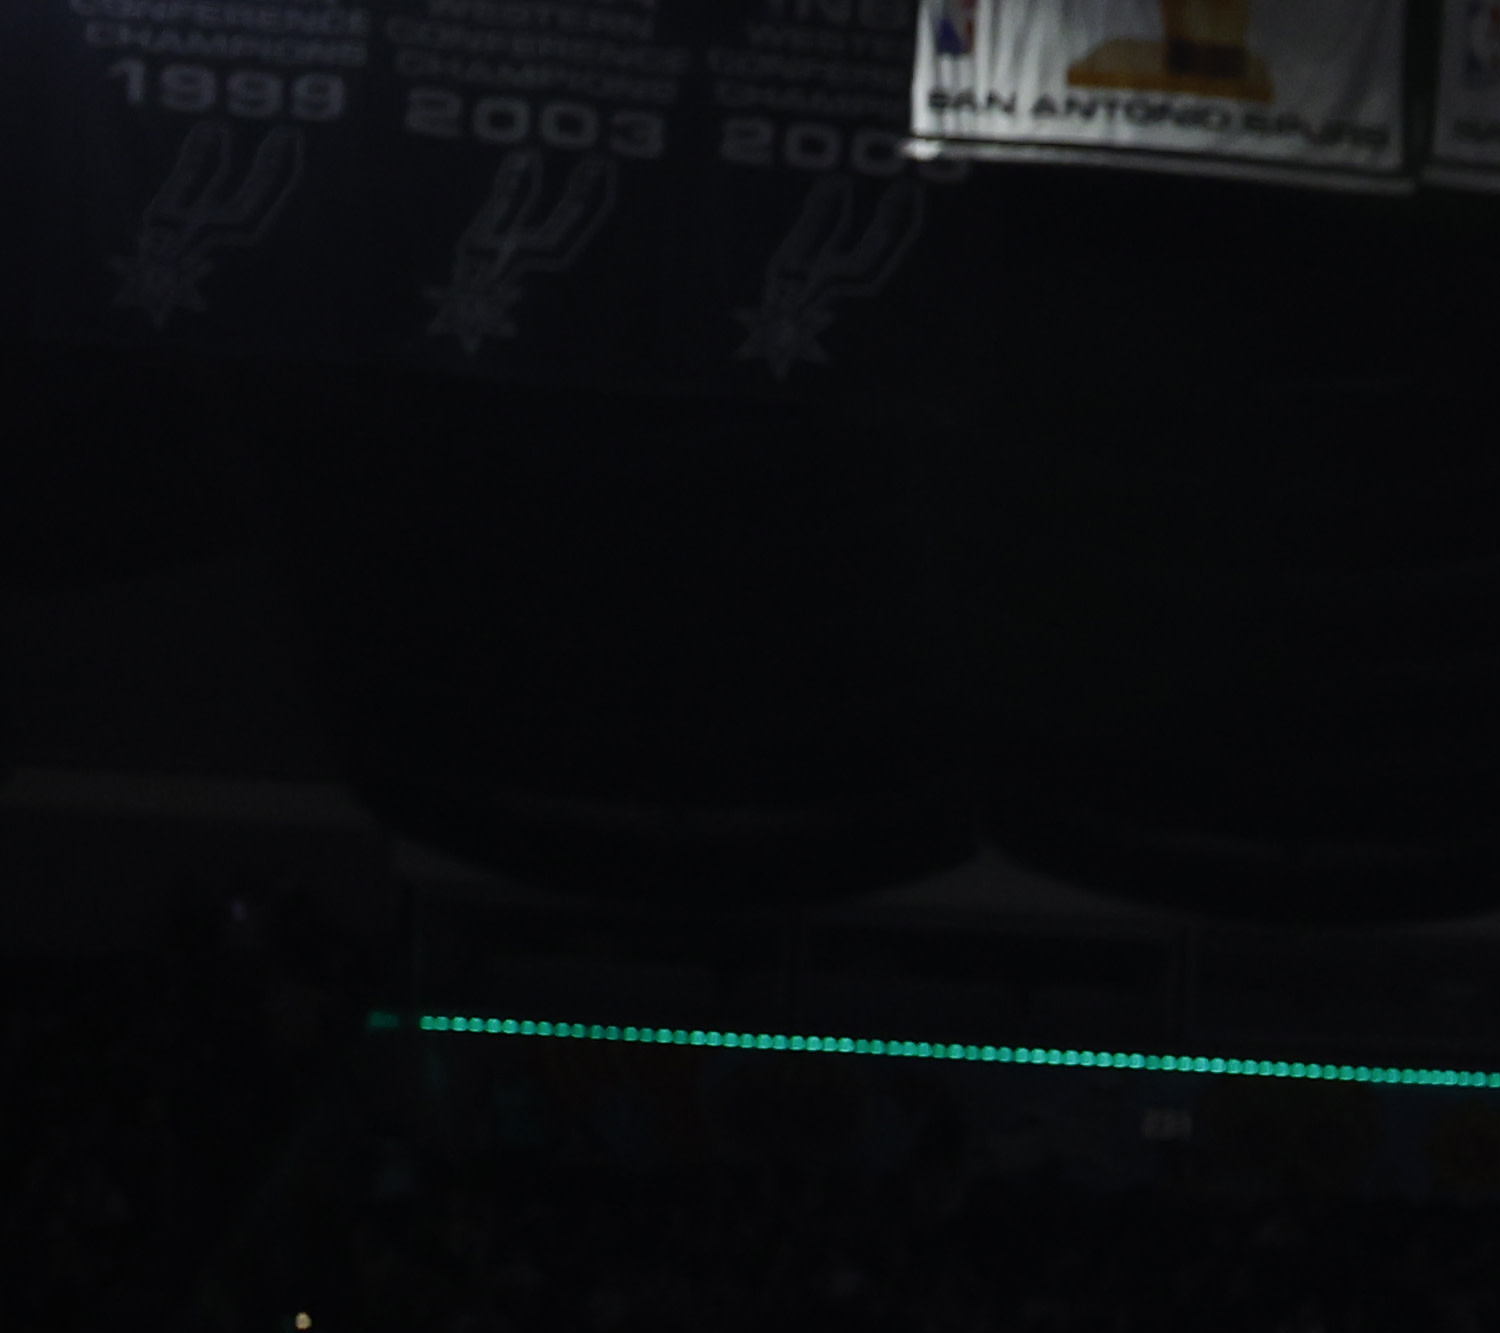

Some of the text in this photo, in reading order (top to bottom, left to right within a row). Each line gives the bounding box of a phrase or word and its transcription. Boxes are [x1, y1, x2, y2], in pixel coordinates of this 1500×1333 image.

[106, 58, 346, 121] 1999
[929, 89, 1017, 117] SAN
[404, 85, 666, 159] 2003
